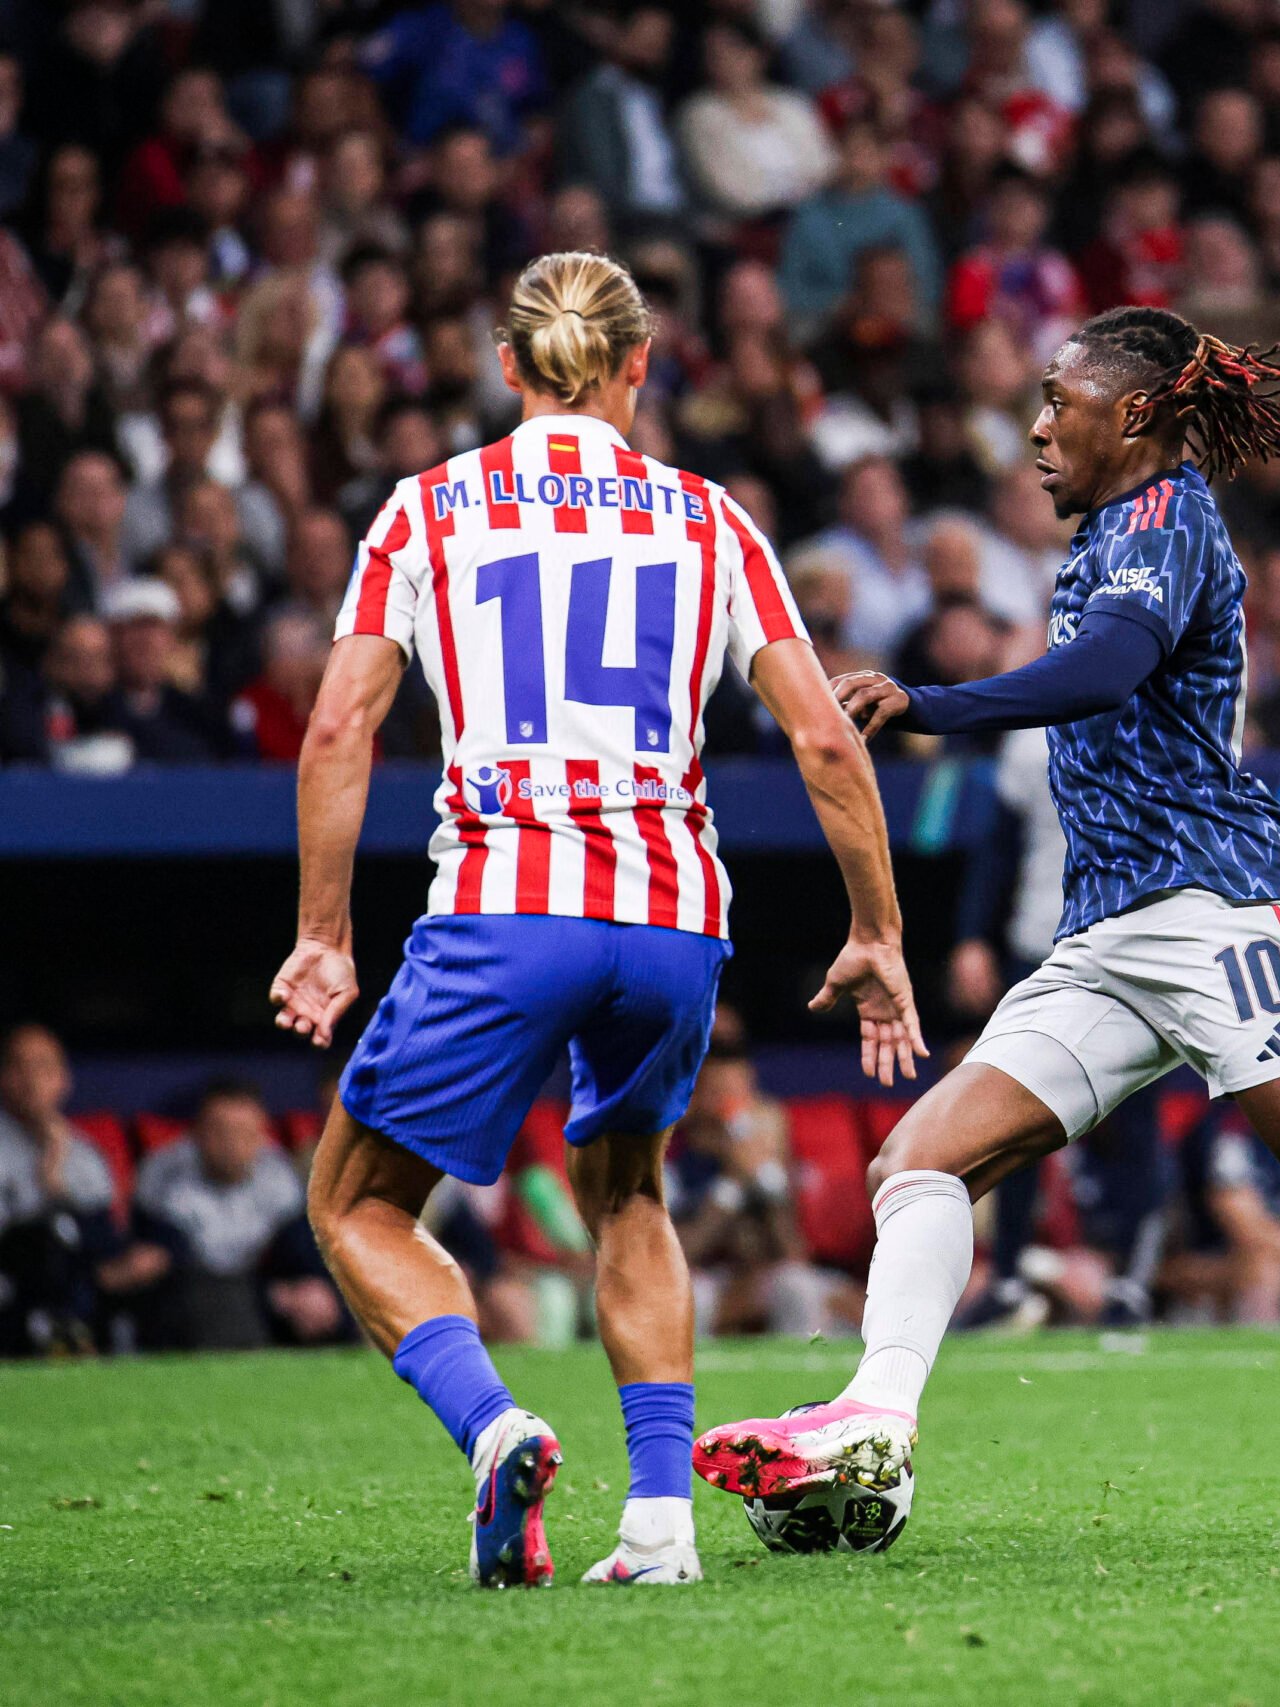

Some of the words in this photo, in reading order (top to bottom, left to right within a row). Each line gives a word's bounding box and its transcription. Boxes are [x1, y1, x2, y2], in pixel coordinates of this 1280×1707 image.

[432, 479, 482, 518] M.
[490, 471, 705, 521] LLORENTE
[1108, 567, 1156, 586] VISIT
[475, 552, 678, 754] 14
[519, 778, 568, 798] Save
[575, 779, 609, 798] the
